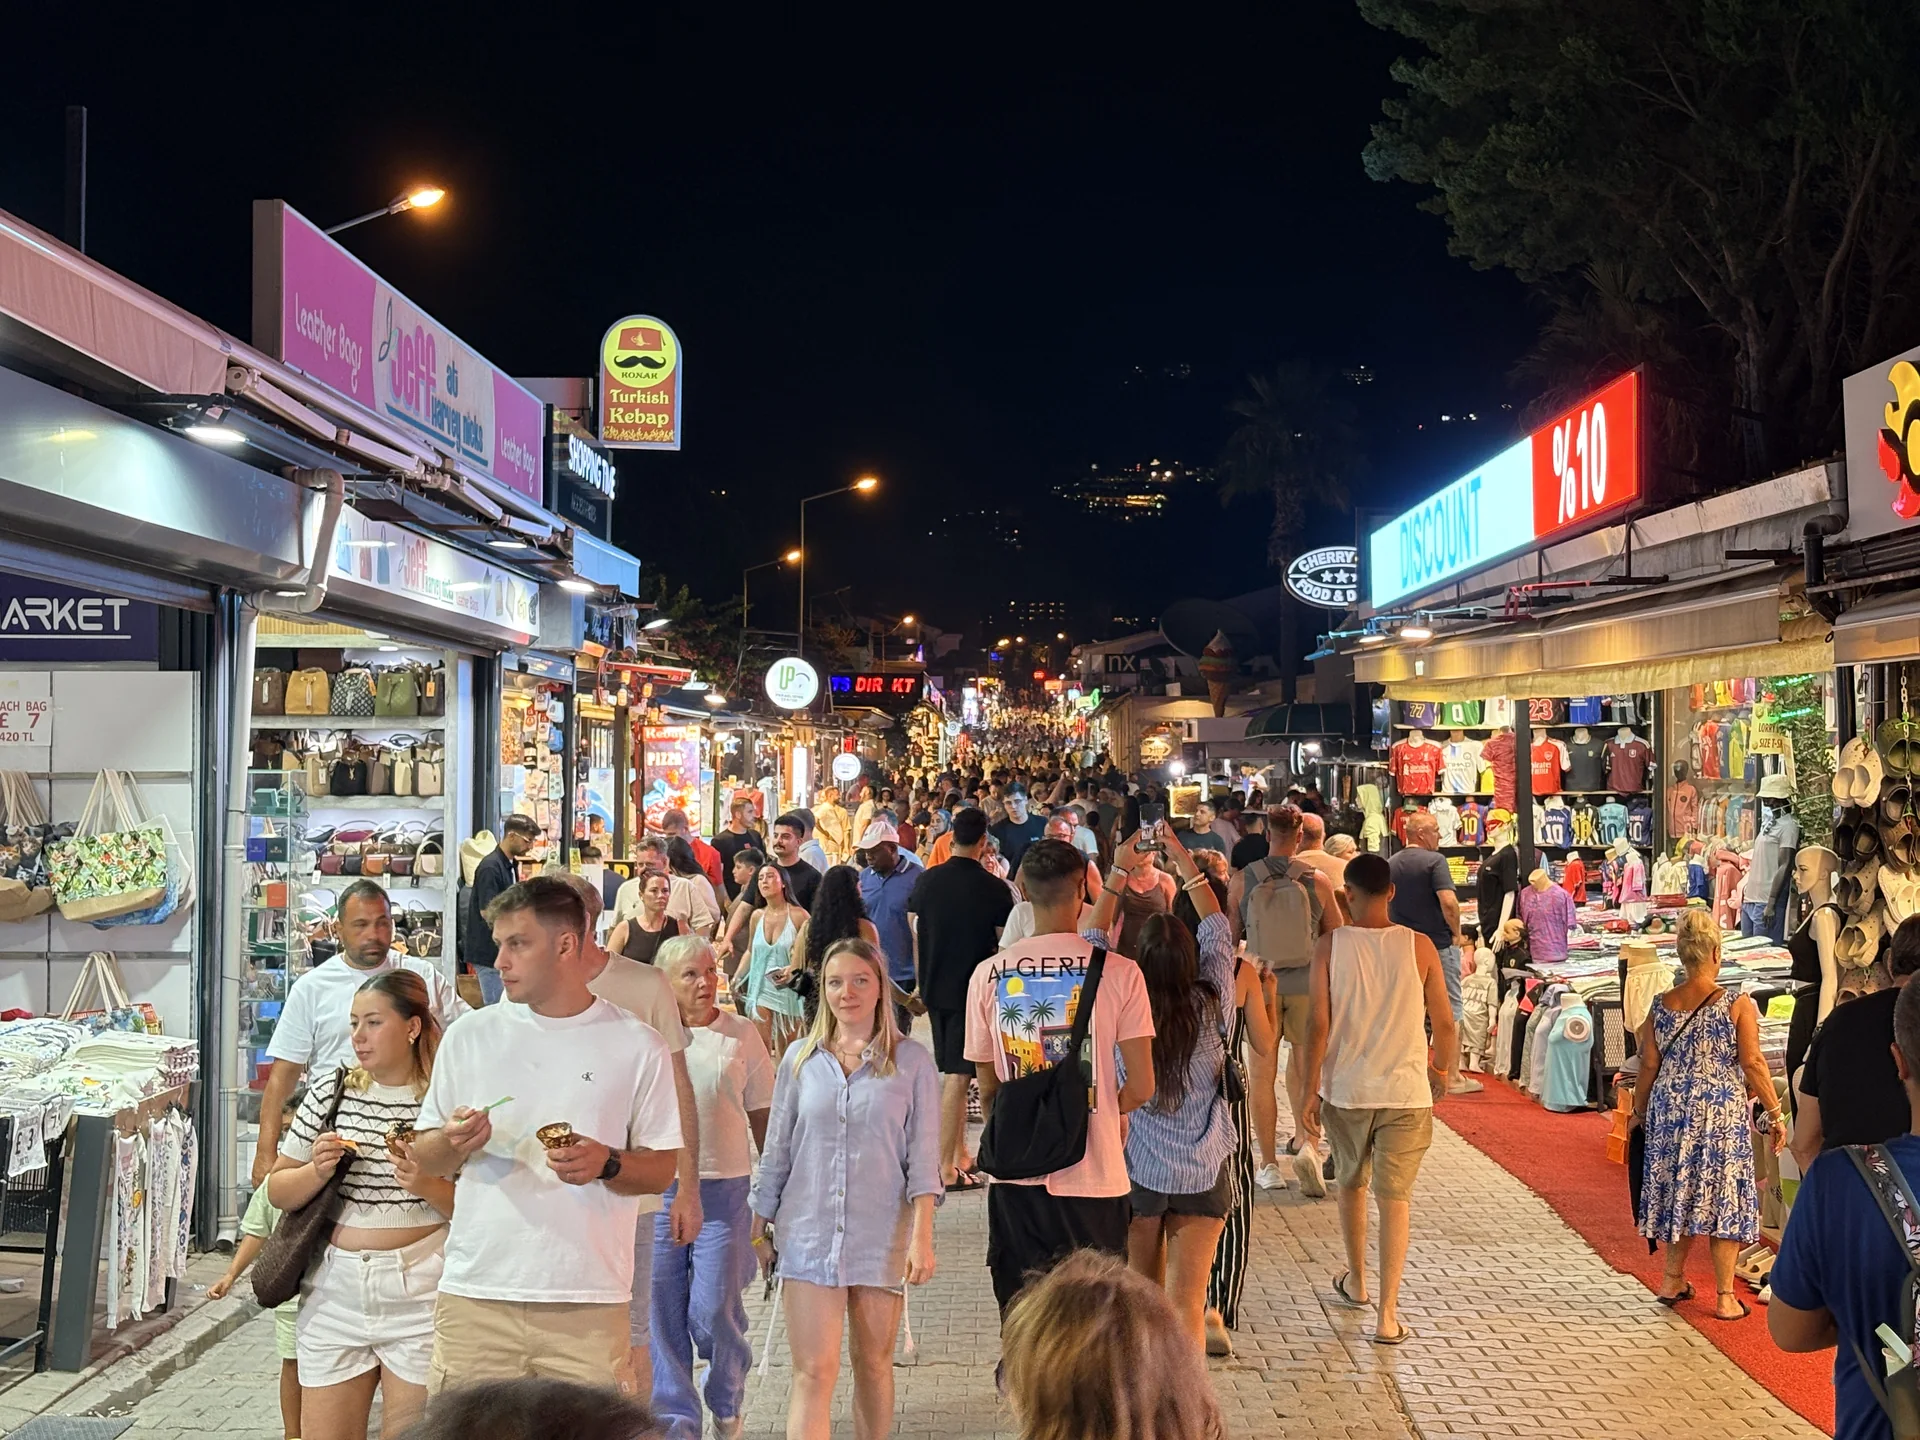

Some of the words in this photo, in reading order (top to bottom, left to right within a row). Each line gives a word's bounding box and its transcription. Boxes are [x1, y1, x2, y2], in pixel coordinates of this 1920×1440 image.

[295, 292, 337, 362] Leather
[339, 322, 363, 394] Bags
[446, 360, 459, 398] at
[609, 388, 670, 405] Turkish
[609, 407, 670, 428] Kebap
[500, 427, 522, 474] Leather
[568, 433, 602, 490] SHOPPING
[1552, 402, 1607, 524] %10
[1401, 474, 1482, 590] DISCOUNT
[1298, 550, 1355, 572] CHERRY
[1295, 578, 1332, 601] FOOD
[1333, 589, 1344, 602] &
[0, 598, 130, 631] ARKET
[1109, 654, 1136, 672] nx
[26, 701, 47, 711] BAG
[1410, 703, 1426, 718] 77
[1529, 699, 1553, 721] 23
[28, 713, 40, 729] 7
[0, 732, 19, 742] 420
[22, 732, 35, 742] TL
[1462, 817, 1478, 836] 10
[1545, 824, 1563, 845] 10
[988, 956, 1103, 984] ALGERI
